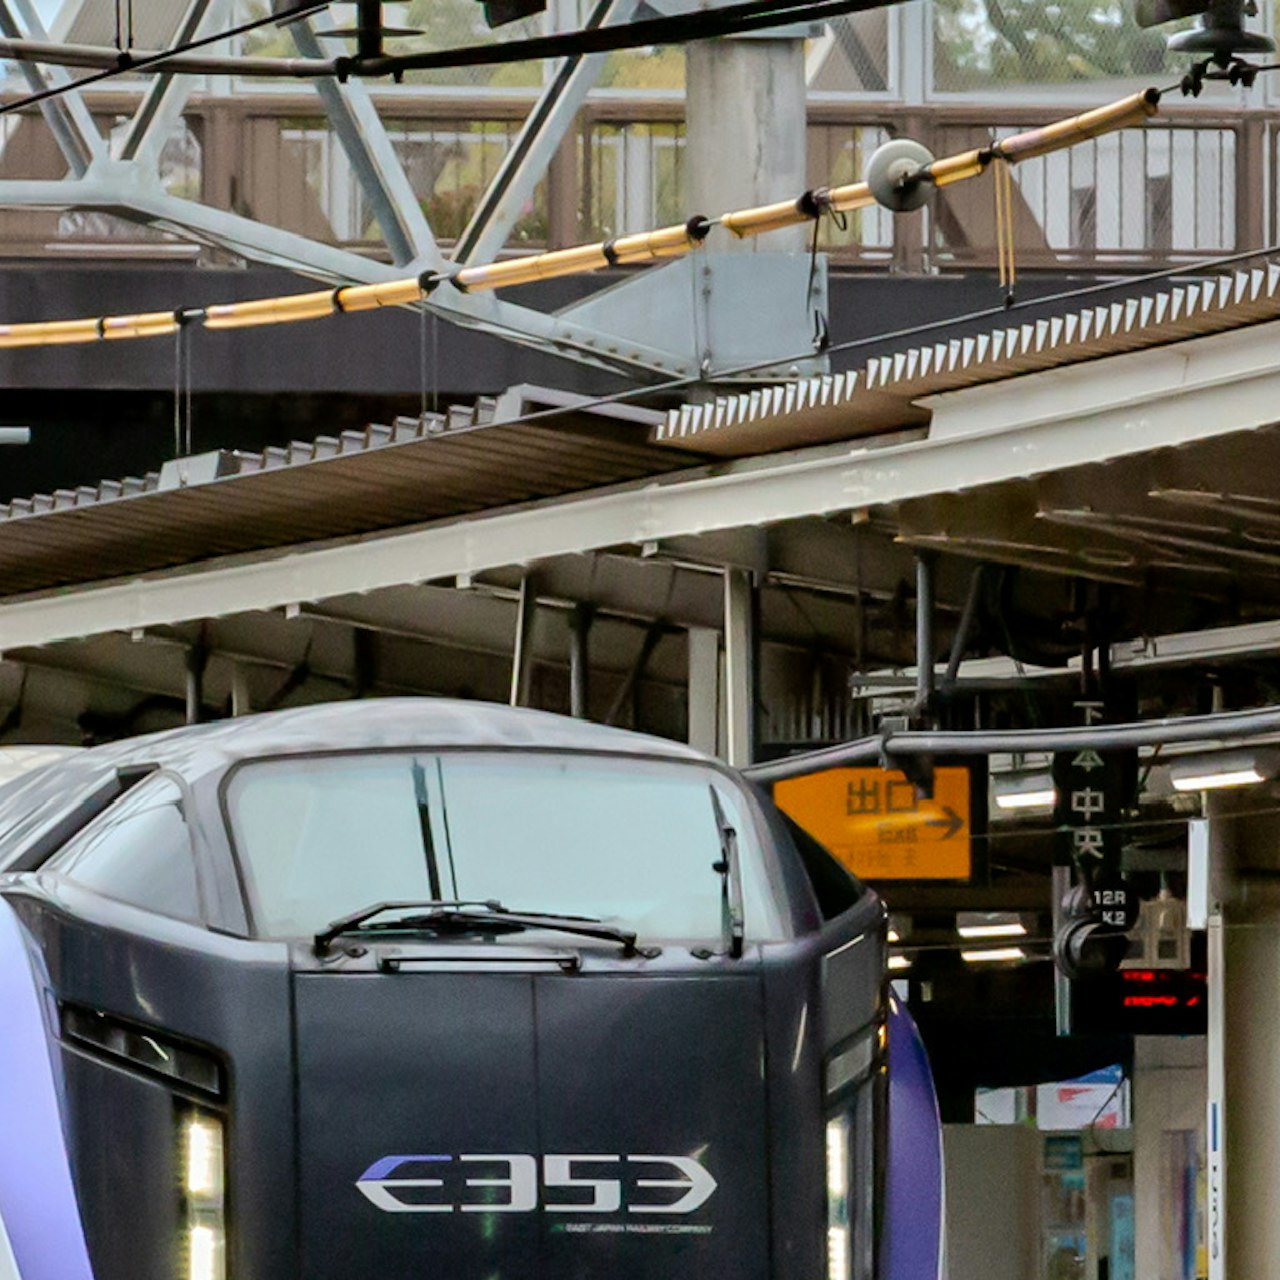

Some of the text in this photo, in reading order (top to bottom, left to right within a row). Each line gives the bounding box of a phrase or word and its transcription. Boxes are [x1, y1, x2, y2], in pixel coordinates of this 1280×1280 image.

[847, 777, 917, 815] 出口
[1093, 891, 1126, 905] 12R
[1102, 911, 1126, 925] K2
[354, 1153, 719, 1214] E353
